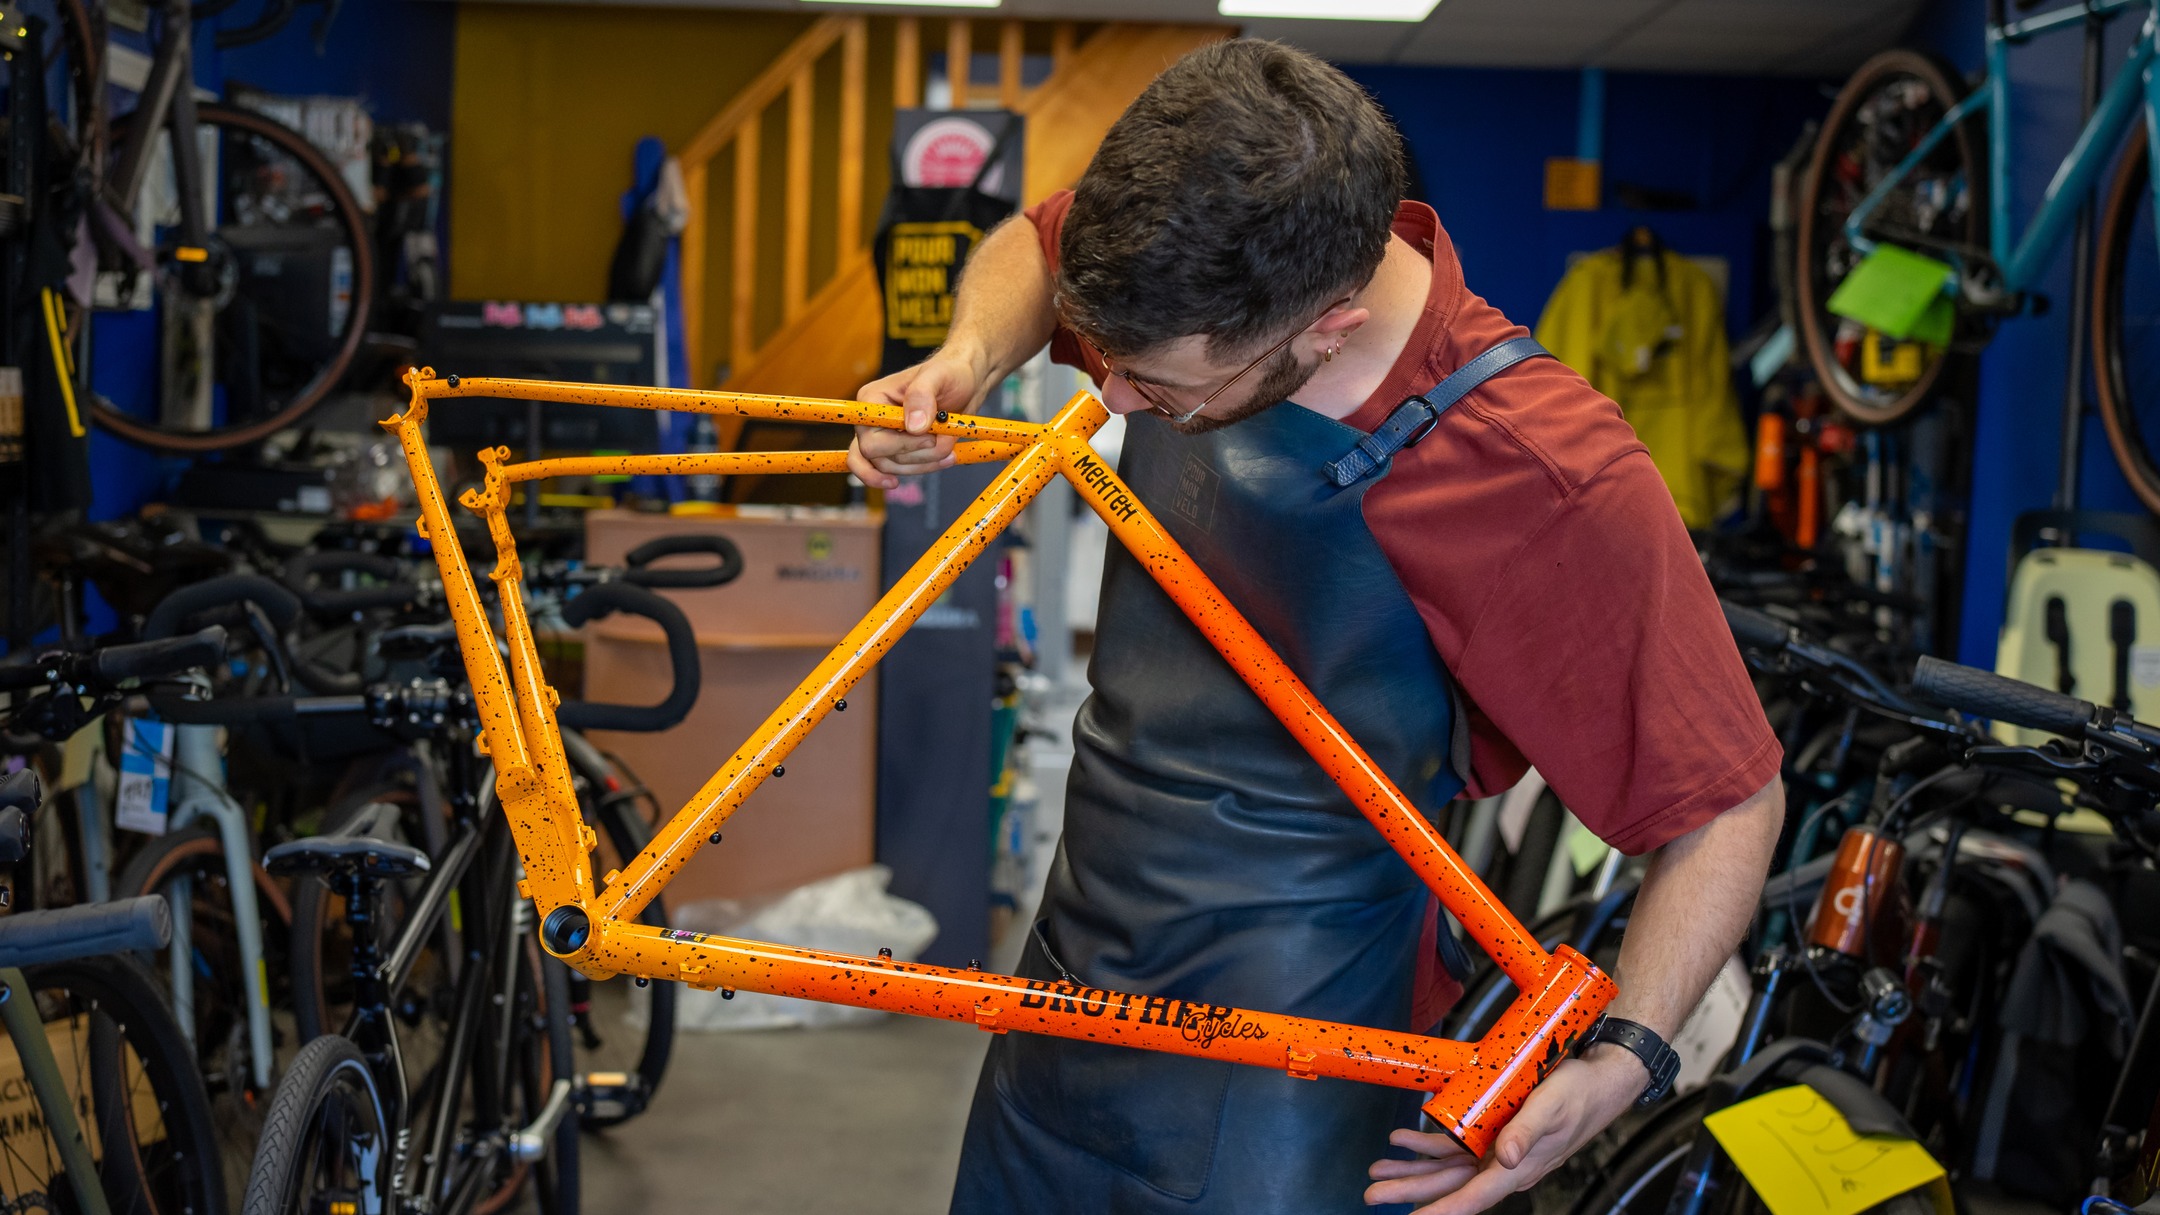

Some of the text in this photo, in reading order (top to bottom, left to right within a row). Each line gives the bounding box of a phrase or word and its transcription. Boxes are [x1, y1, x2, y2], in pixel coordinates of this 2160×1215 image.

[894, 236, 956, 266] POUR
[897, 267, 948, 294] MON
[1184, 460, 1206, 487] POUR
[1180, 479, 1200, 501] MON
[1176, 495, 1198, 519] VELO
[1019, 979, 1234, 1030] BROTHER
[1181, 1011, 1269, 1049] Cycles
